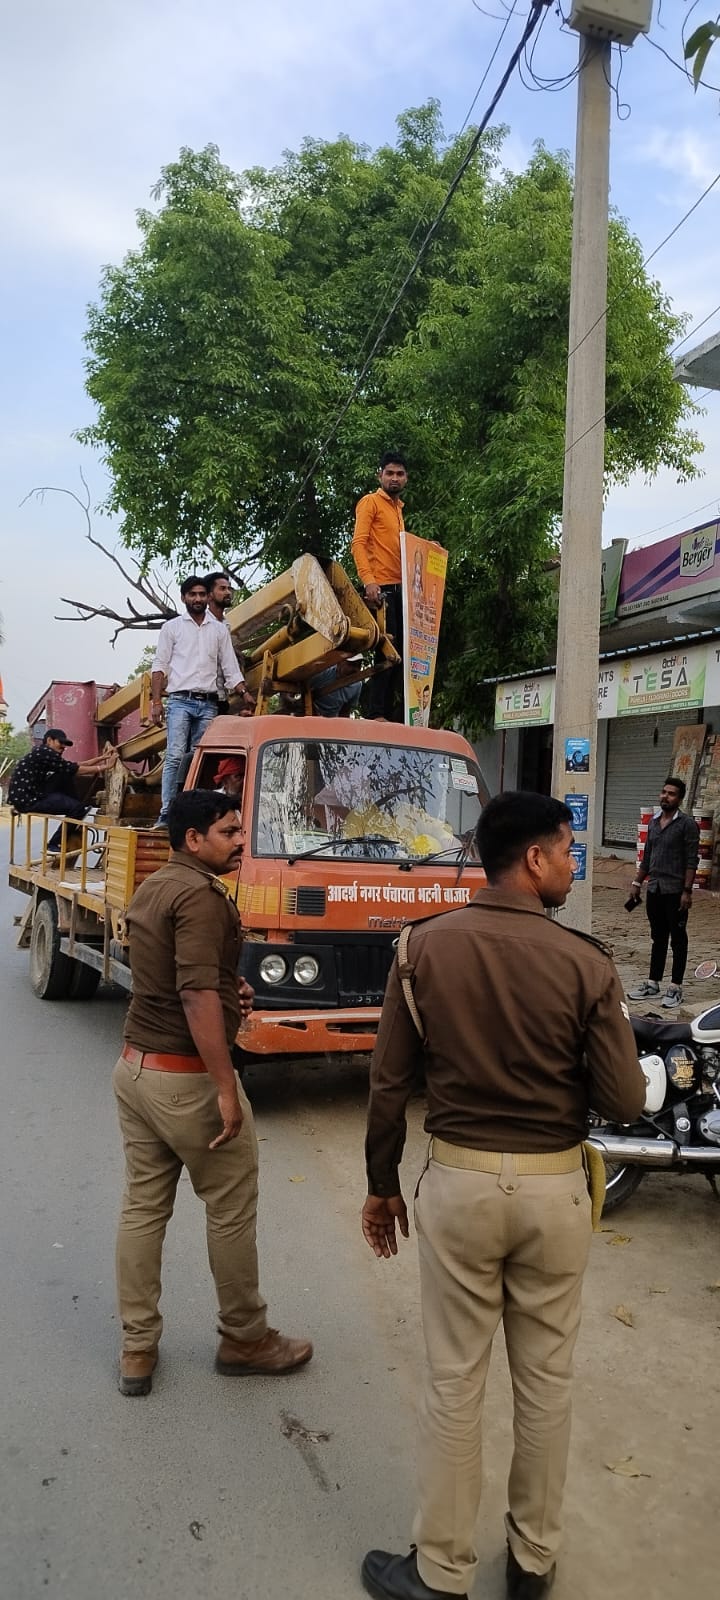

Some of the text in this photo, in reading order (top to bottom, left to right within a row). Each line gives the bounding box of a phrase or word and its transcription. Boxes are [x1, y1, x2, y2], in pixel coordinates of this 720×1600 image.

[682, 547, 712, 568] Berger
[633, 667, 688, 693] TESA
[505, 691, 540, 711] TESA
[327, 880, 471, 903] आदर्श नगर पंचायत भटनी बाजार
